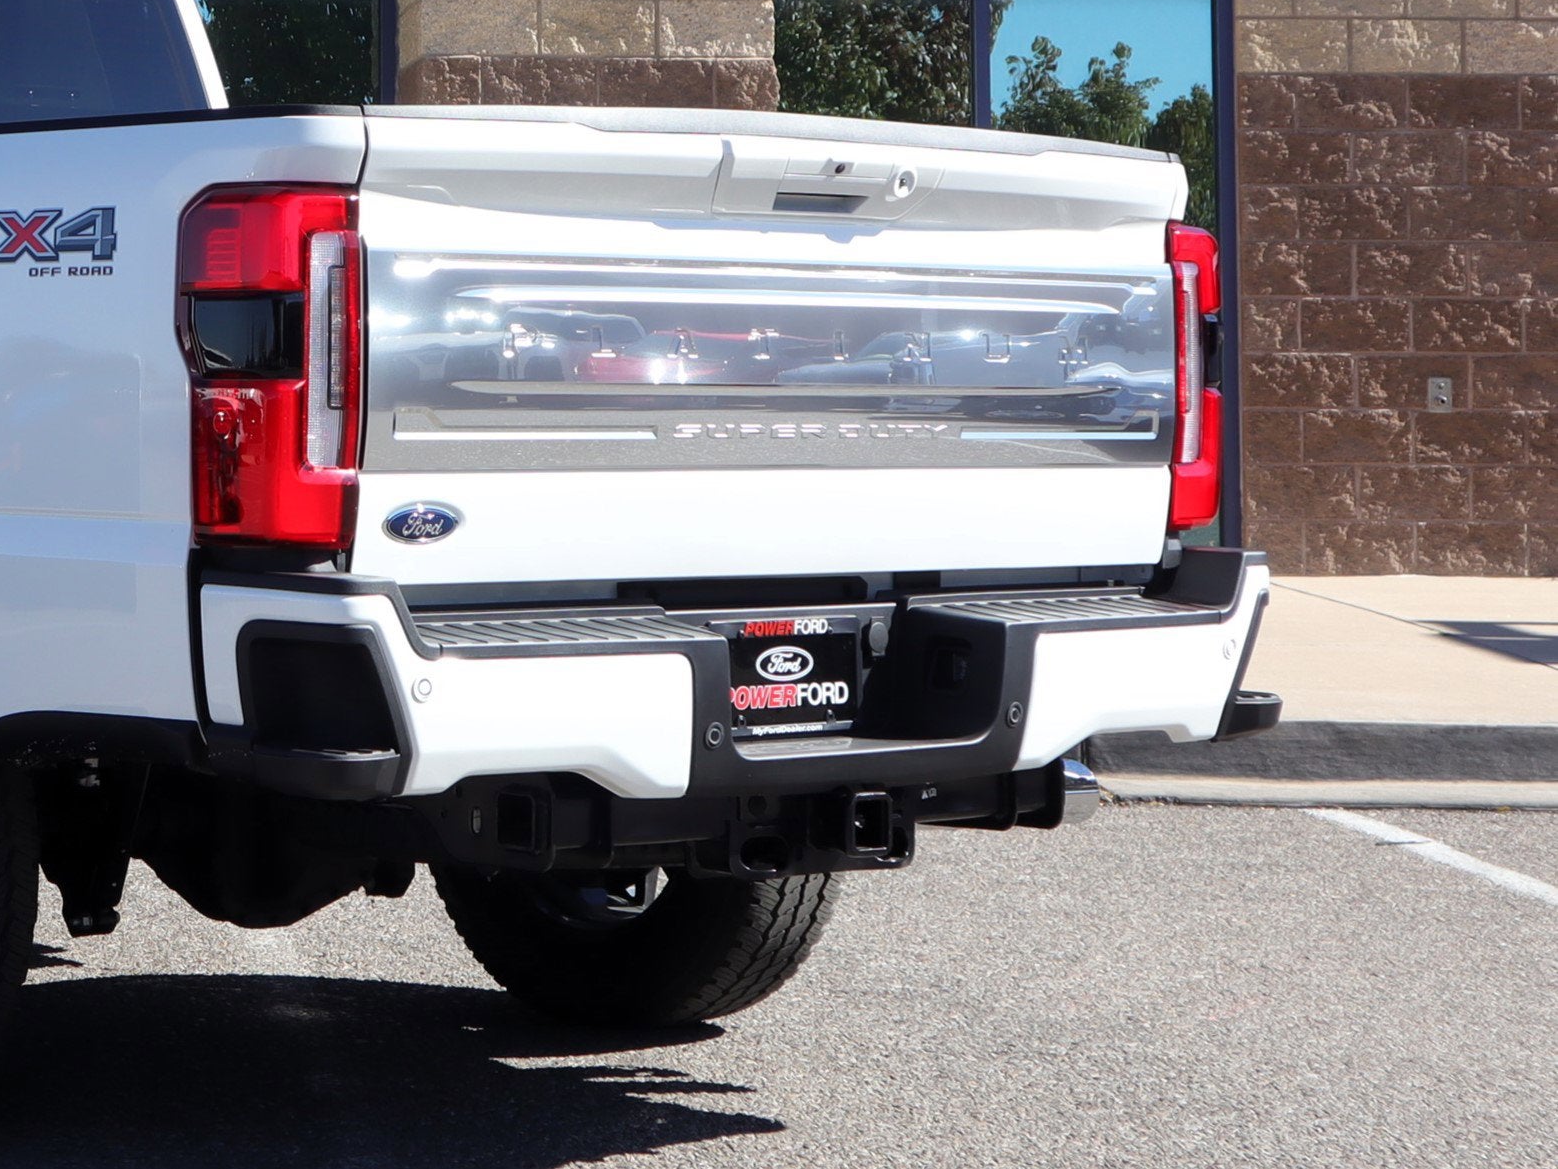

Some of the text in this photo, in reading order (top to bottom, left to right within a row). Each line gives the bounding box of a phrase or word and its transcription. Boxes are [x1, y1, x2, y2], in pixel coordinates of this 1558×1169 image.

[29, 265, 114, 278] OFF ROAD
[502, 324, 1089, 365] PLATINUM
[673, 423, 948, 439] SUPER DUTY
[402, 512, 444, 536] Ford
[744, 618, 829, 637] POWERFORD
[767, 652, 802, 674] Ford
